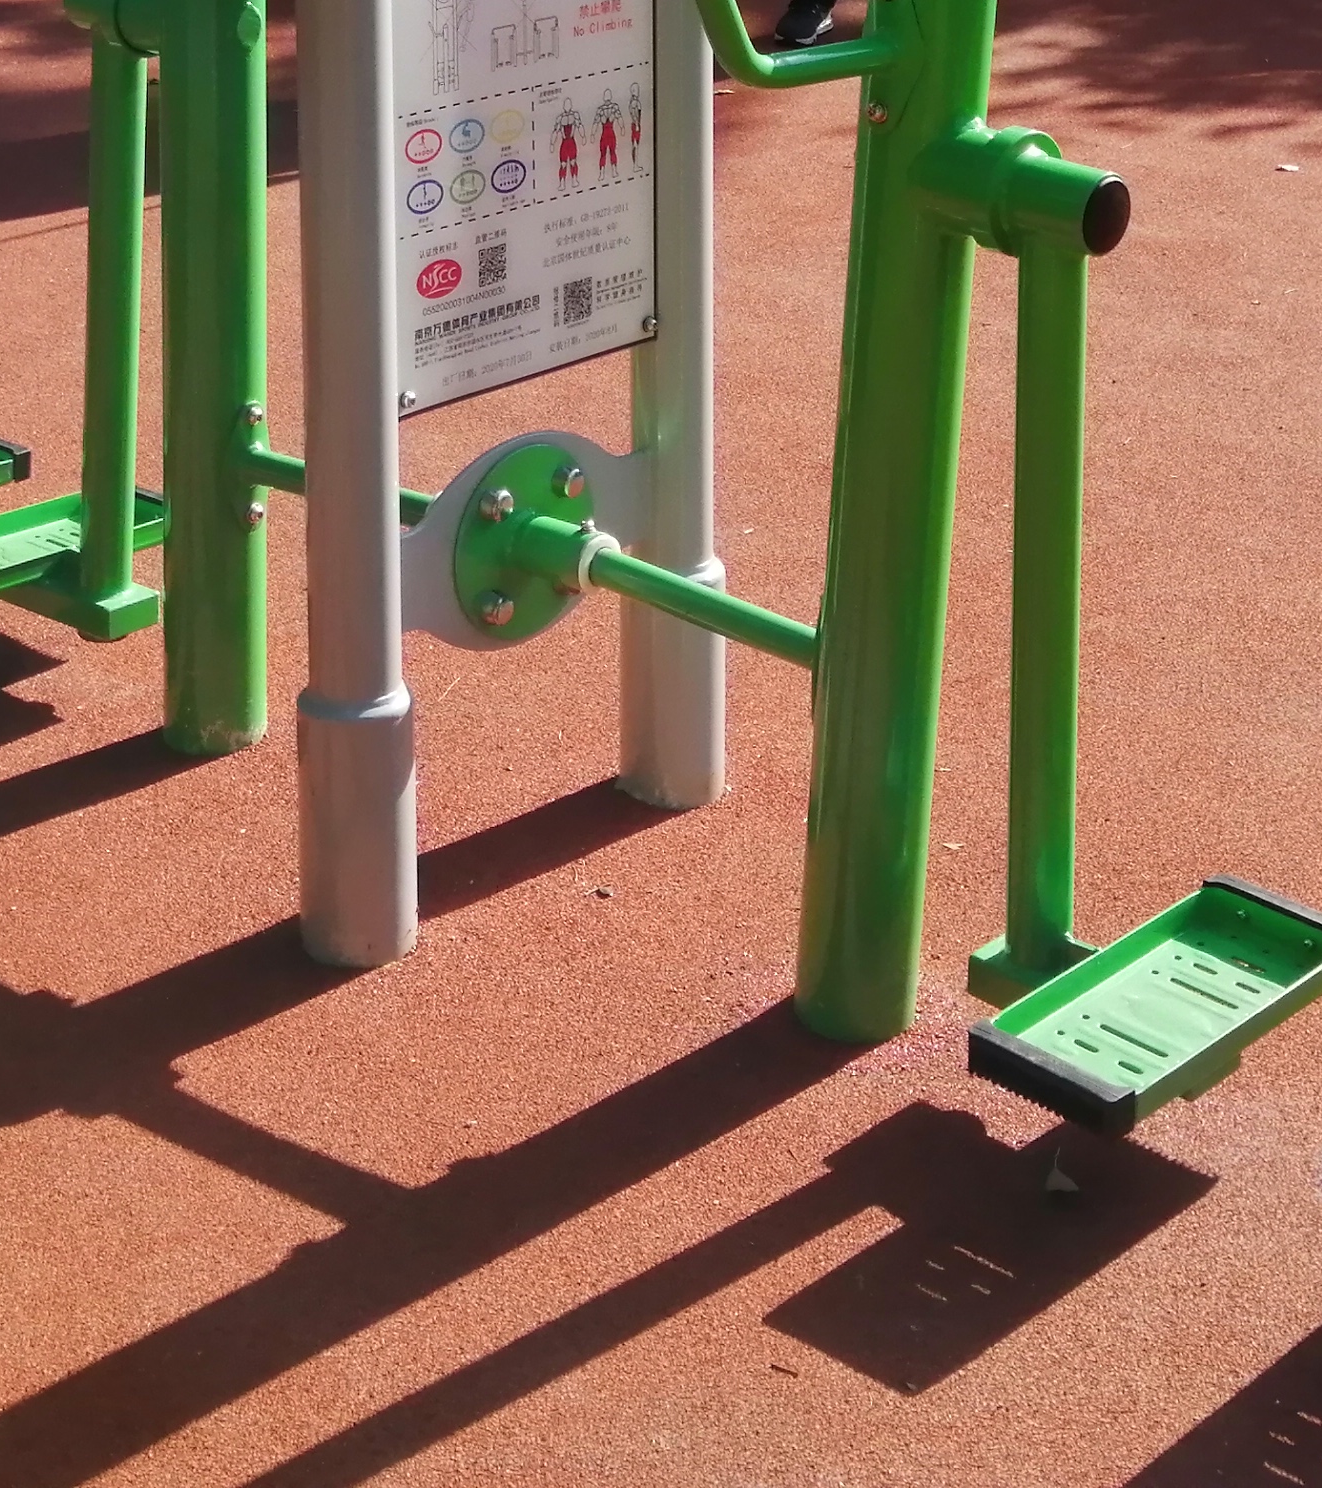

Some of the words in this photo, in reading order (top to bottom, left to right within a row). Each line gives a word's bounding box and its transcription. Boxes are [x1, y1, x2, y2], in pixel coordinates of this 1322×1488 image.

[573, 26, 585, 38] No
[589, 18, 633, 35] Climbing
[422, 264, 458, 291] NSCC
[414, 294, 541, 341] 南京万德体育产业集团有限公司
